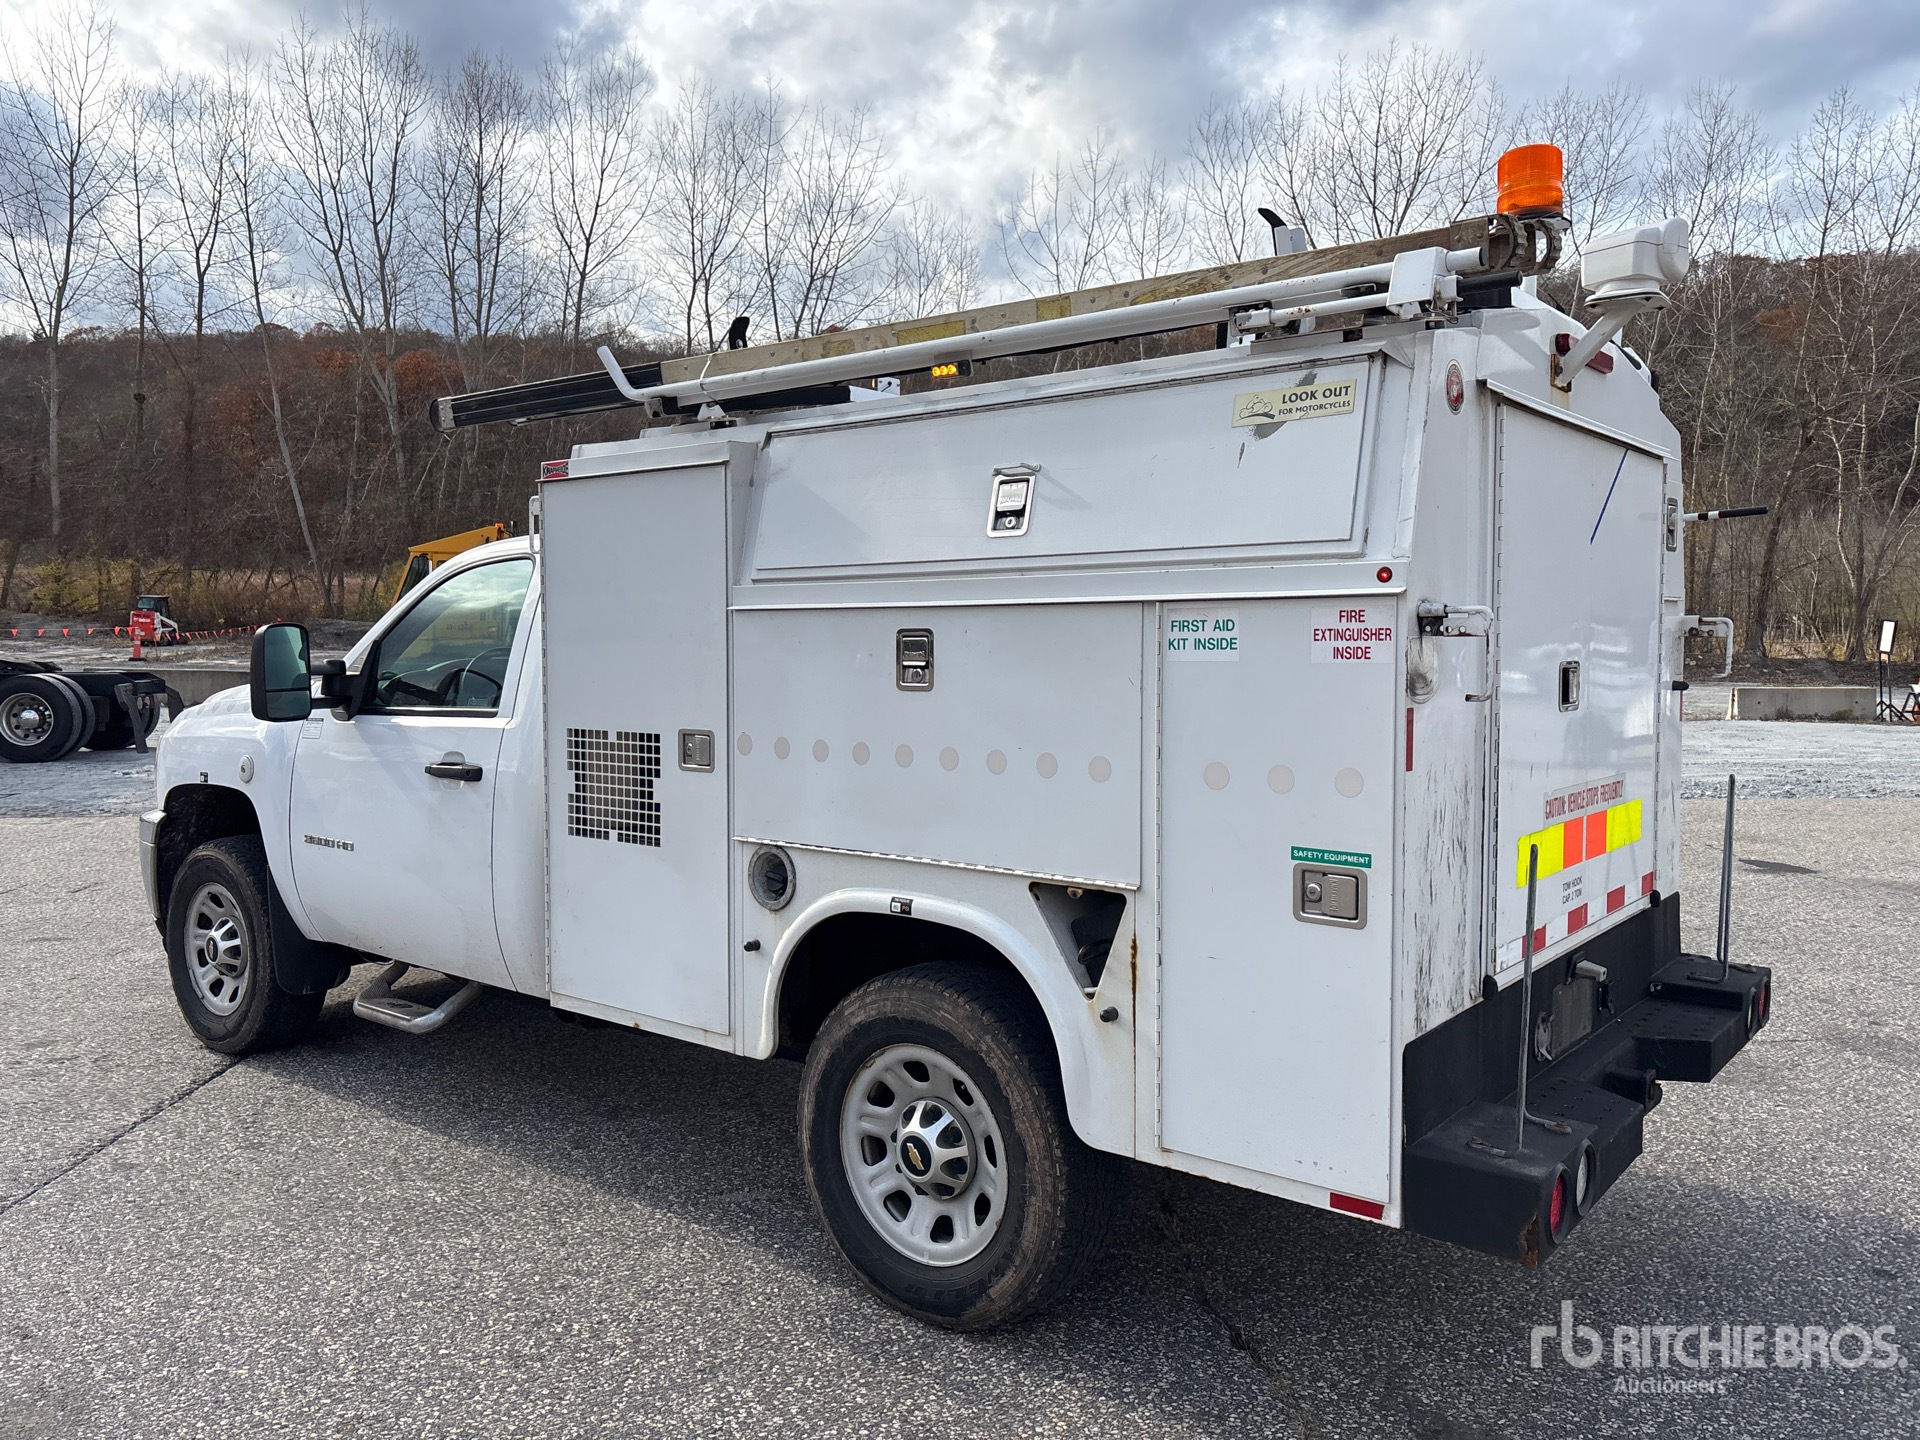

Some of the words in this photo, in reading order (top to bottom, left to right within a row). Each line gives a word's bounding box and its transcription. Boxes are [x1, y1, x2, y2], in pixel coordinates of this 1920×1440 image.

[1282, 389, 1319, 404] LOOK
[1322, 385, 1351, 399] OUT
[1278, 407, 1293, 416] FOR
[1295, 400, 1351, 413] MOTORCYCLES
[1338, 609, 1366, 623] FIRE
[1170, 619, 1207, 633] FIRST
[1213, 618, 1235, 632] AID
[1313, 627, 1392, 642] EXTINGUISHER
[1168, 637, 1188, 651] KIT
[1194, 637, 1238, 651] INSIDE
[1333, 646, 1371, 660] INSIDE
[1586, 785, 1599, 807] STOPS
[1293, 849, 1322, 859] SAFETY
[1324, 853, 1370, 864] EQUIPMENT
[1562, 880, 1571, 892] TOW
[1572, 875, 1583, 888] HOOK
[1574, 888, 1582, 899] TON
